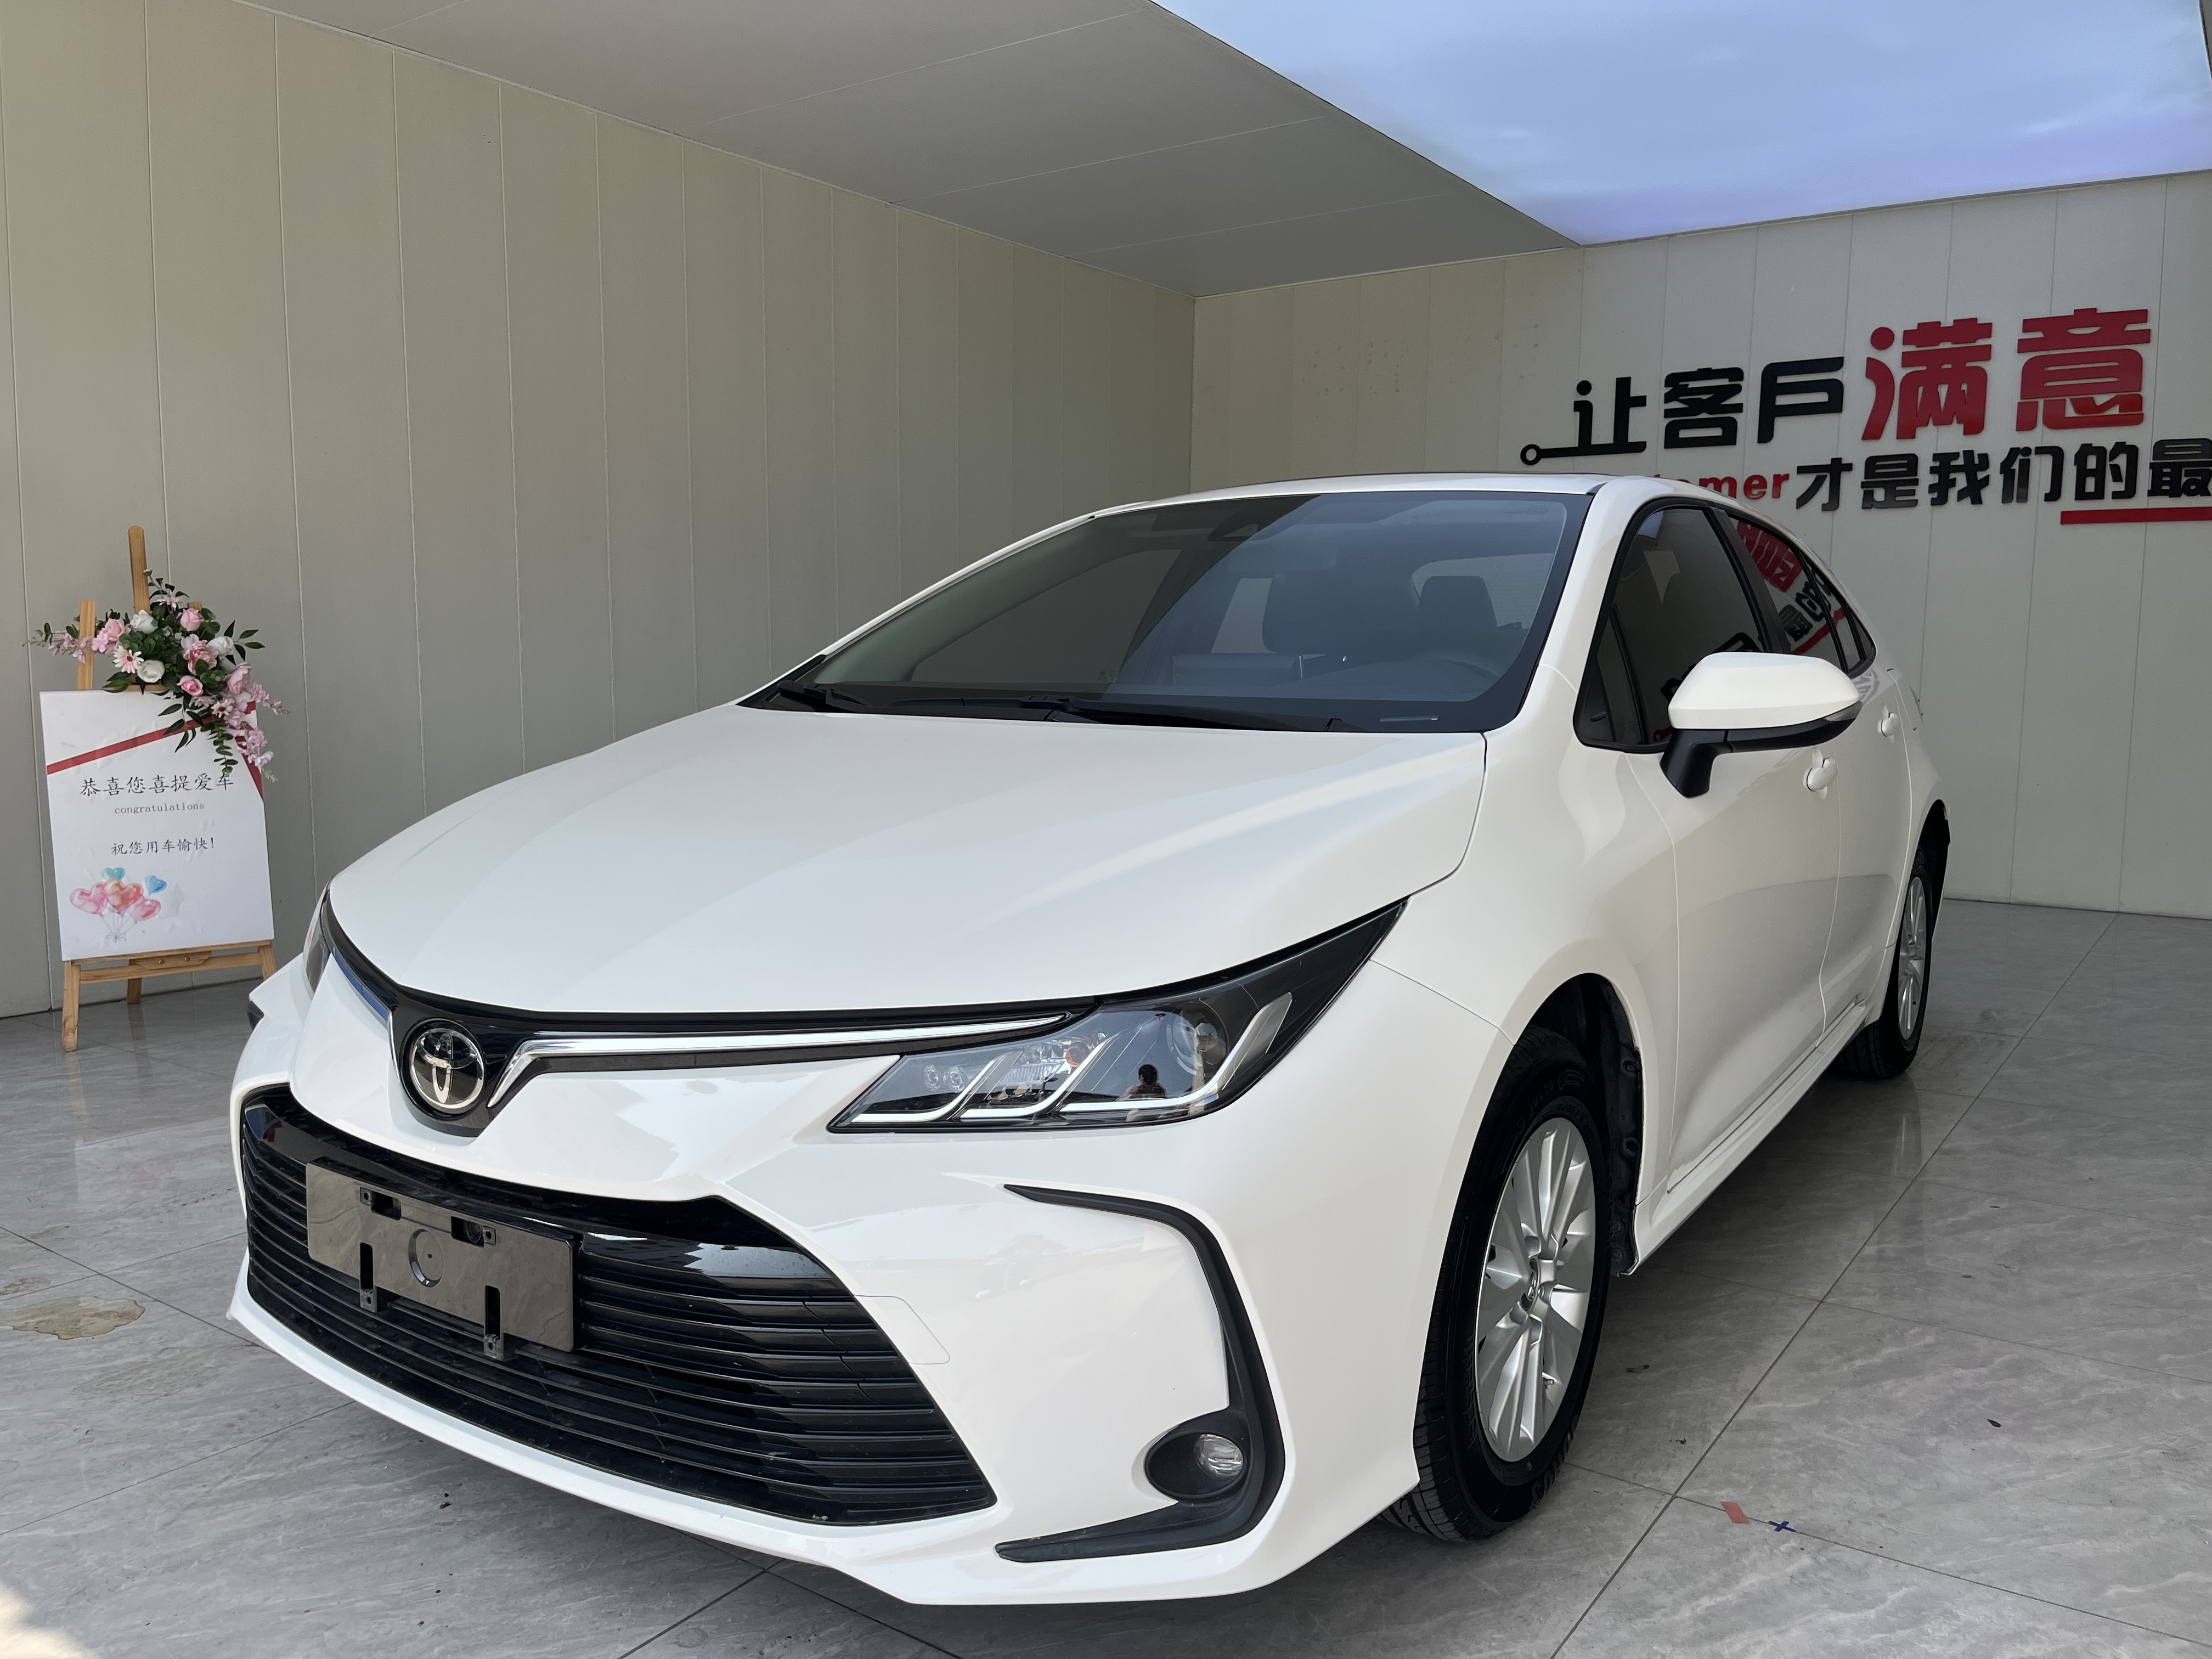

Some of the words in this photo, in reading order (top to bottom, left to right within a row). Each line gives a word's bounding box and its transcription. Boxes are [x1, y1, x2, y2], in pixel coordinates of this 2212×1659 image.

[1654, 473, 1790, 500] mer
[1796, 438, 2212, 512] 才是我们的最
[80, 772, 234, 797] 恭喜您喜提爱车
[114, 802, 205, 814] congratulations
